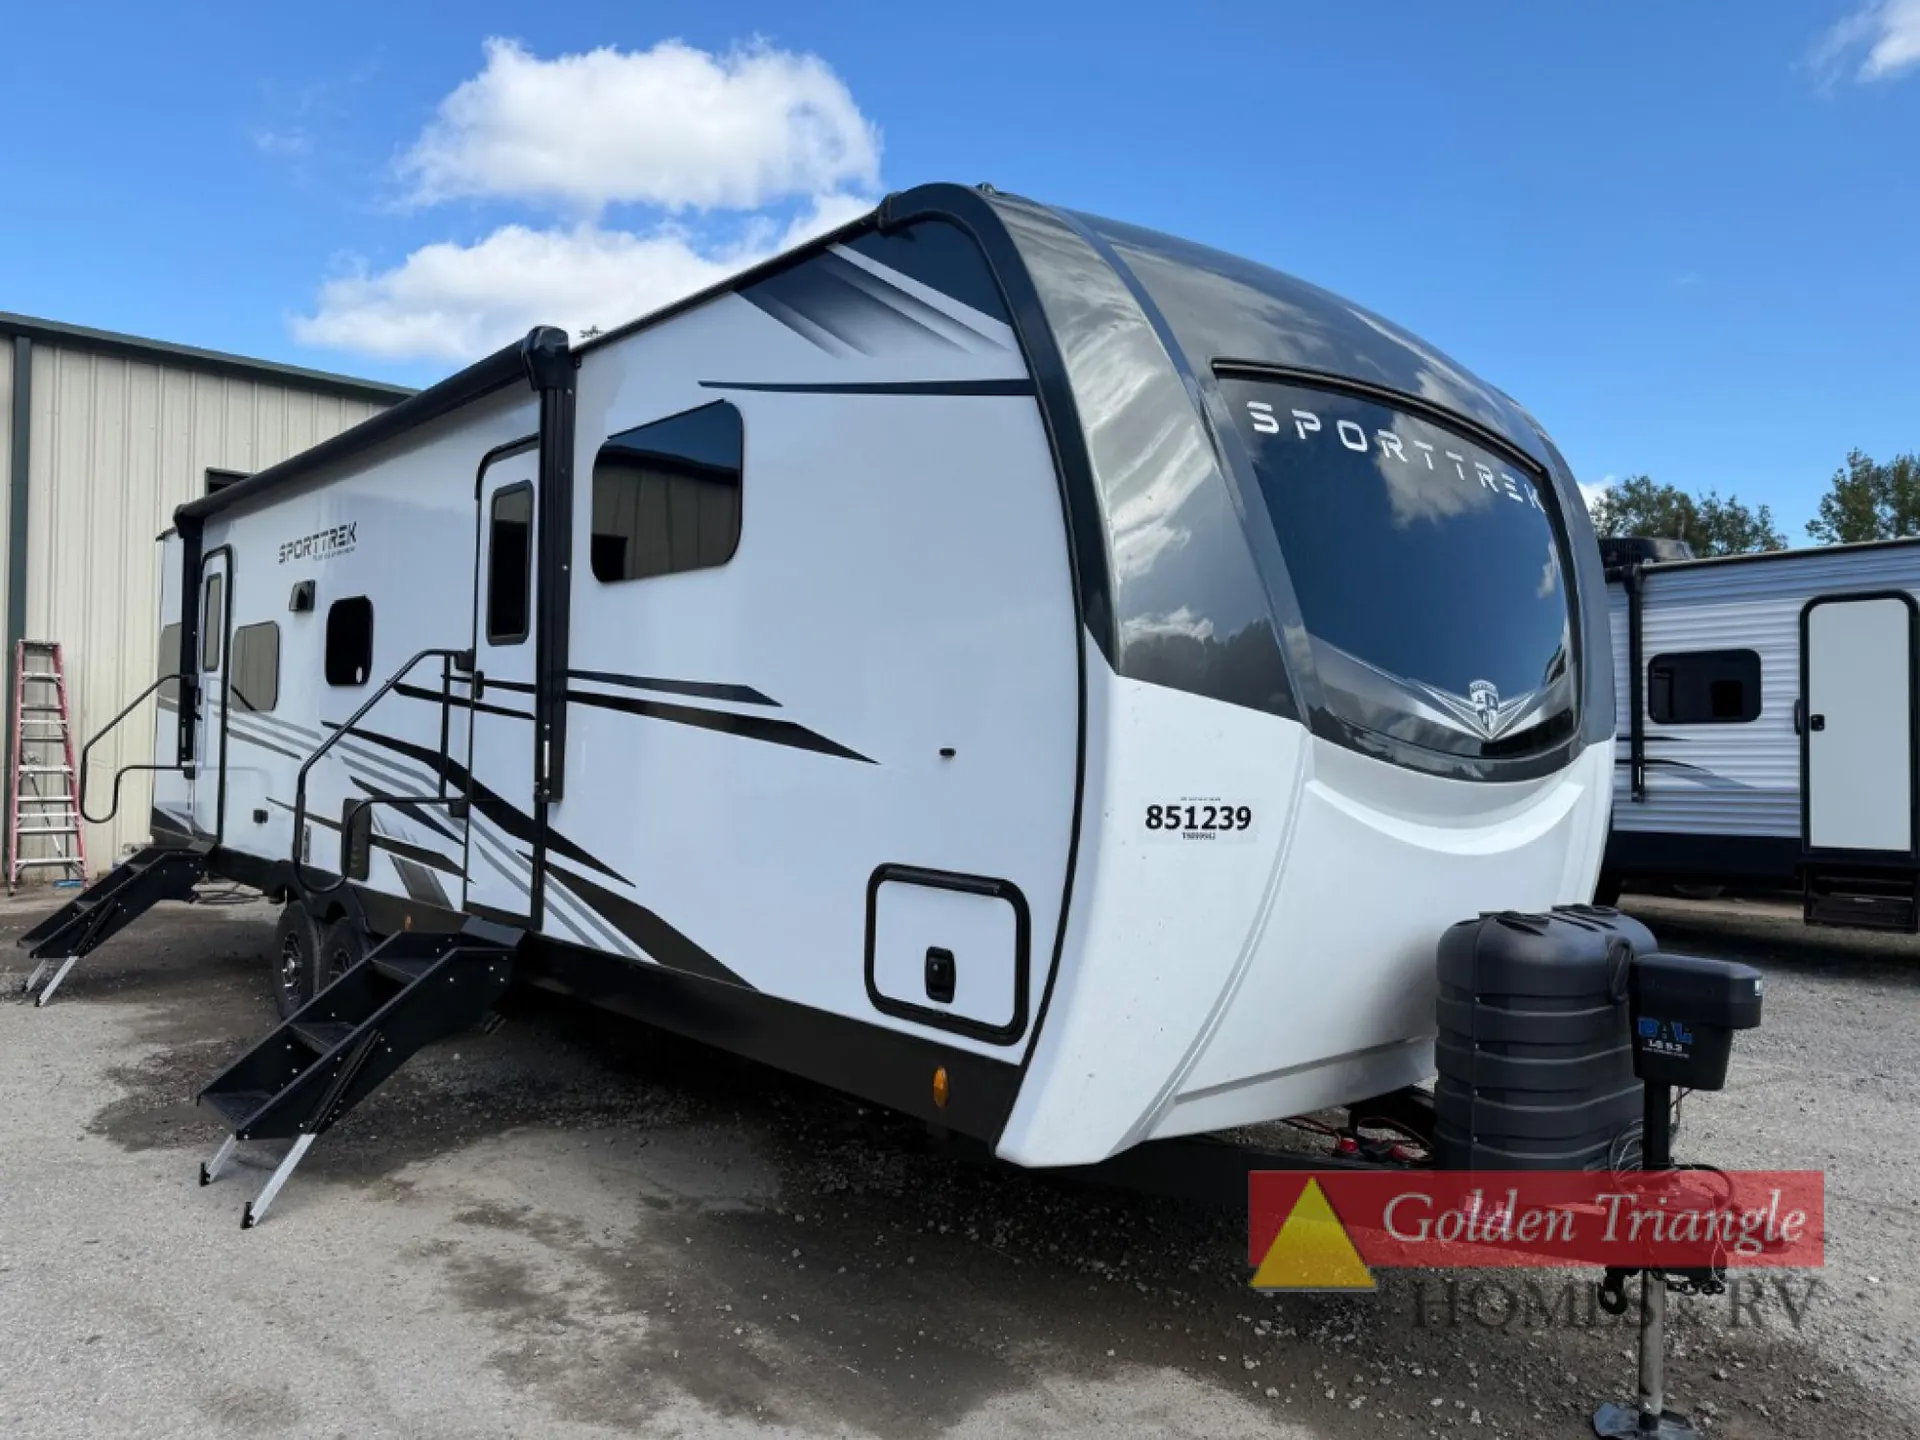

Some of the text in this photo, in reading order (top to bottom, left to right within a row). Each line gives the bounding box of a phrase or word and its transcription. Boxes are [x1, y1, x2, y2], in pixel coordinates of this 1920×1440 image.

[1246, 400, 1546, 513] SPORTTREK
[278, 520, 357, 565] SPORTTREK
[1145, 804, 1252, 831] 851239
